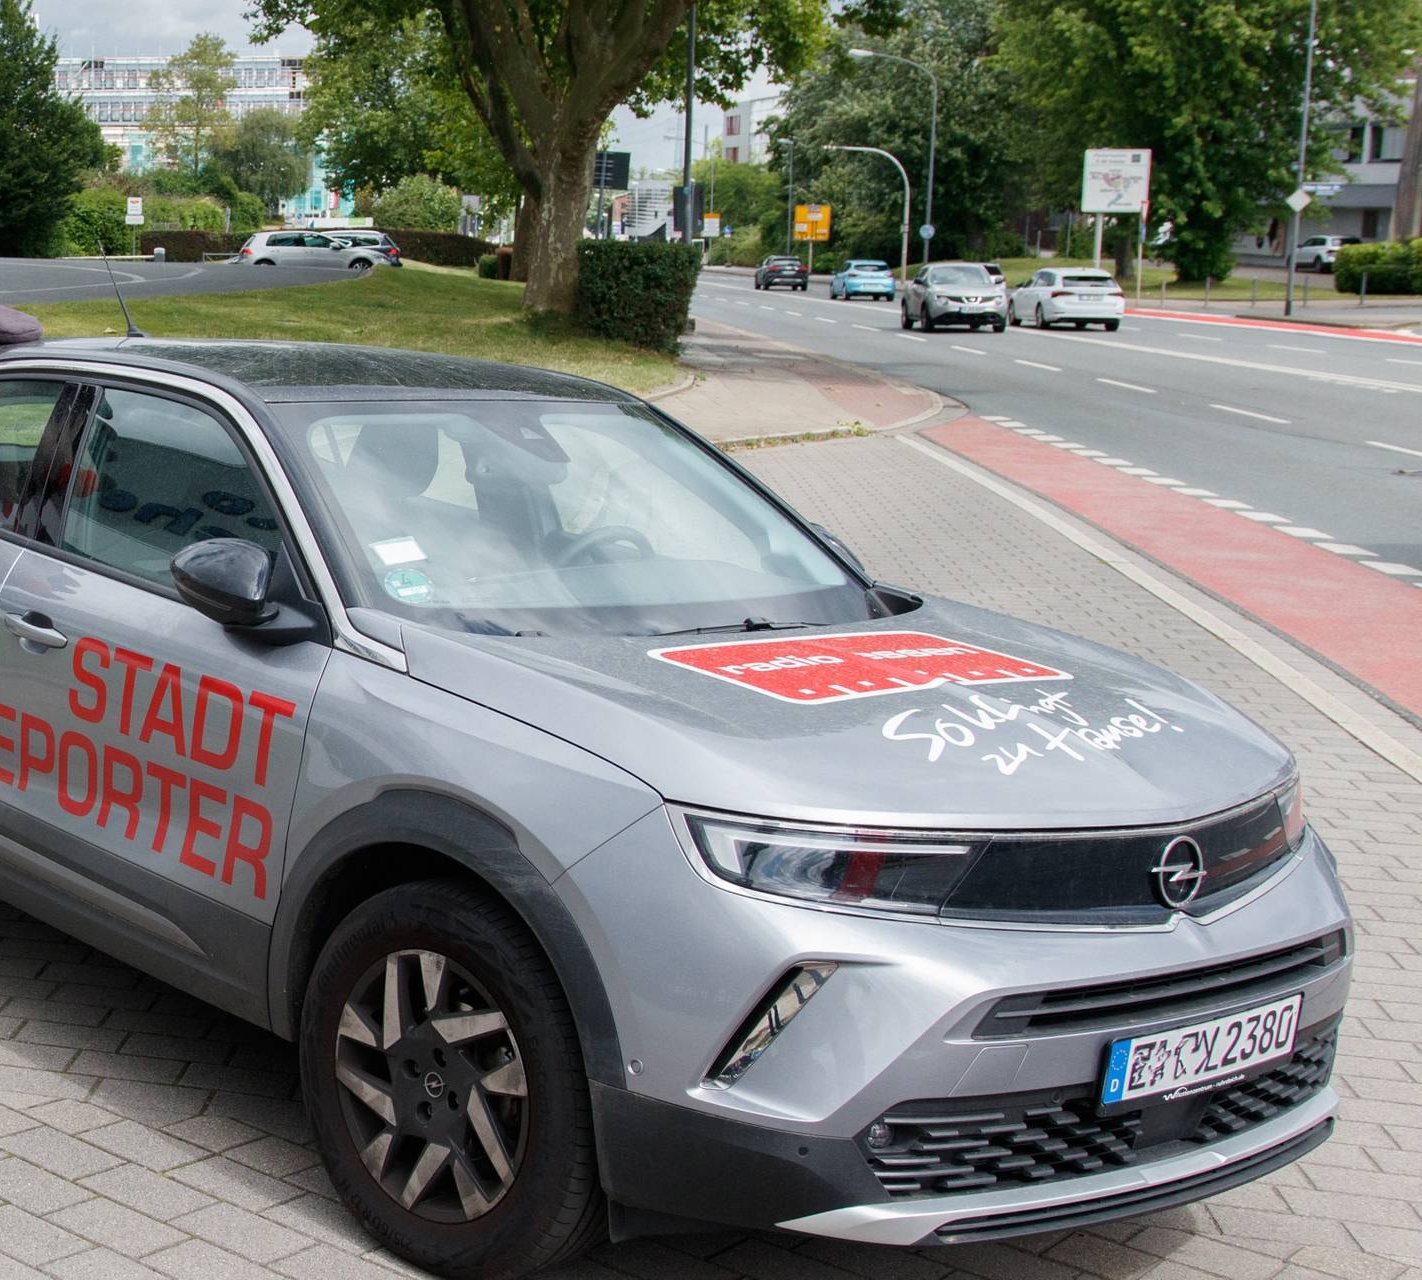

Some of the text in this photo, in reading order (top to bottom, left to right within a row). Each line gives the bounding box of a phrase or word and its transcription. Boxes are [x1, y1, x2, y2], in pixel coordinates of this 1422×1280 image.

[716, 646, 980, 676] radio essen
[68, 636, 297, 788] STADT
[881, 688, 1090, 763] So klingt
[981, 698, 1185, 776] zu Hause!
[1110, 1078, 1119, 1093] D
